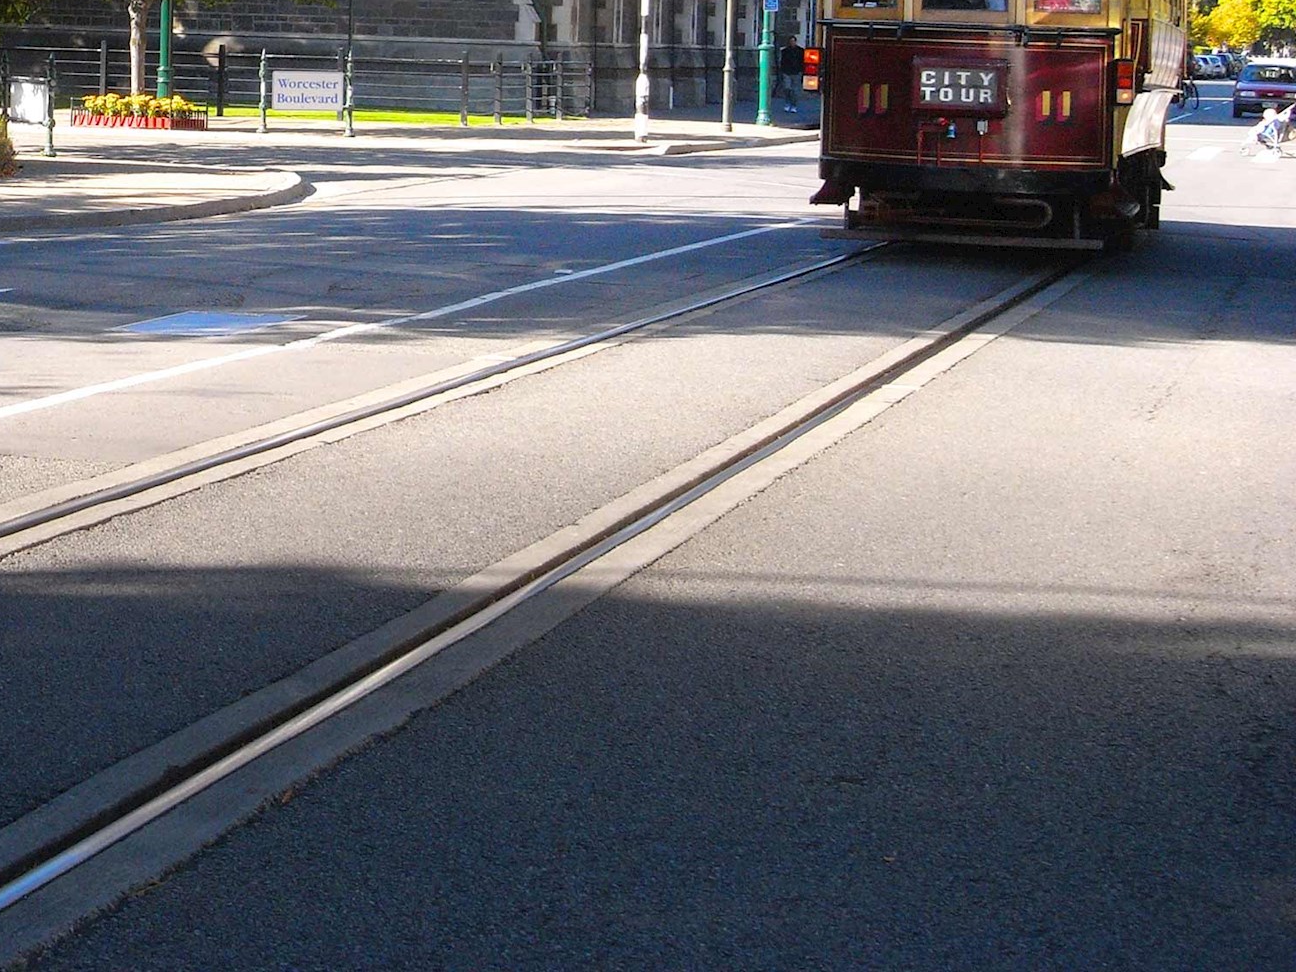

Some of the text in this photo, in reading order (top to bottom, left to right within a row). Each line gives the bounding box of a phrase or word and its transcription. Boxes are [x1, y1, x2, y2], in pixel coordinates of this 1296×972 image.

[278, 78, 339, 89] Worcester
[921, 70, 994, 86] CITY
[277, 93, 338, 104] Boulevard
[921, 87, 993, 103] TOUR
